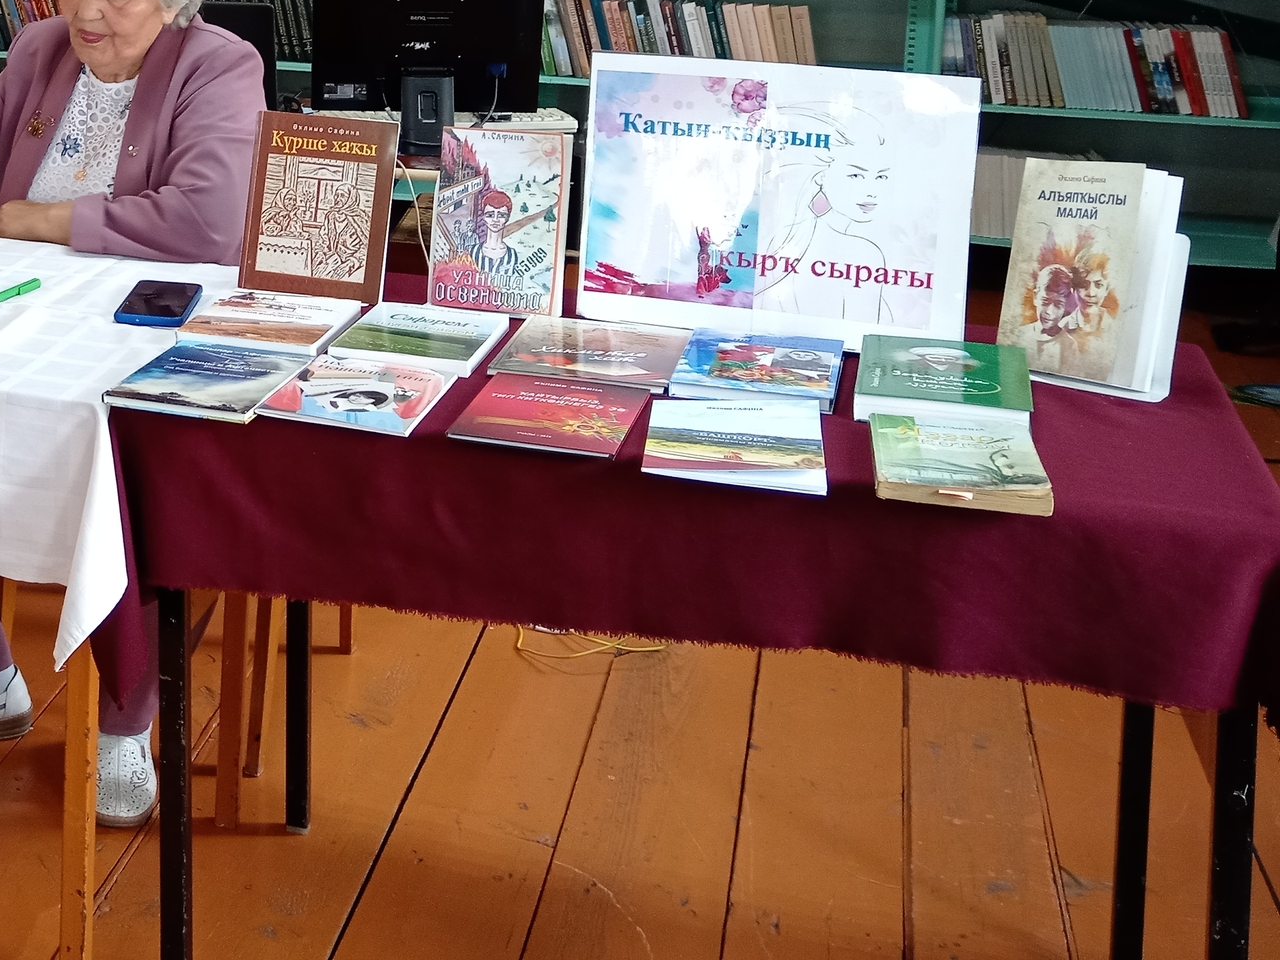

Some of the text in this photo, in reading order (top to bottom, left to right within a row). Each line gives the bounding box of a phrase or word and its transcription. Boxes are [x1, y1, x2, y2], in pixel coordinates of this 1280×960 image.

[974, 22, 983, 49] ЗАГОН
[271, 130, 327, 153] Күрше
[328, 125, 360, 136] Сафина
[1083, 175, 1106, 184] Сафина
[1056, 207, 1098, 220] МАЛАЙ
[515, 248, 547, 277] 65989
[453, 270, 525, 291] УЗНИЦА
[810, 260, 934, 289] сырағы
